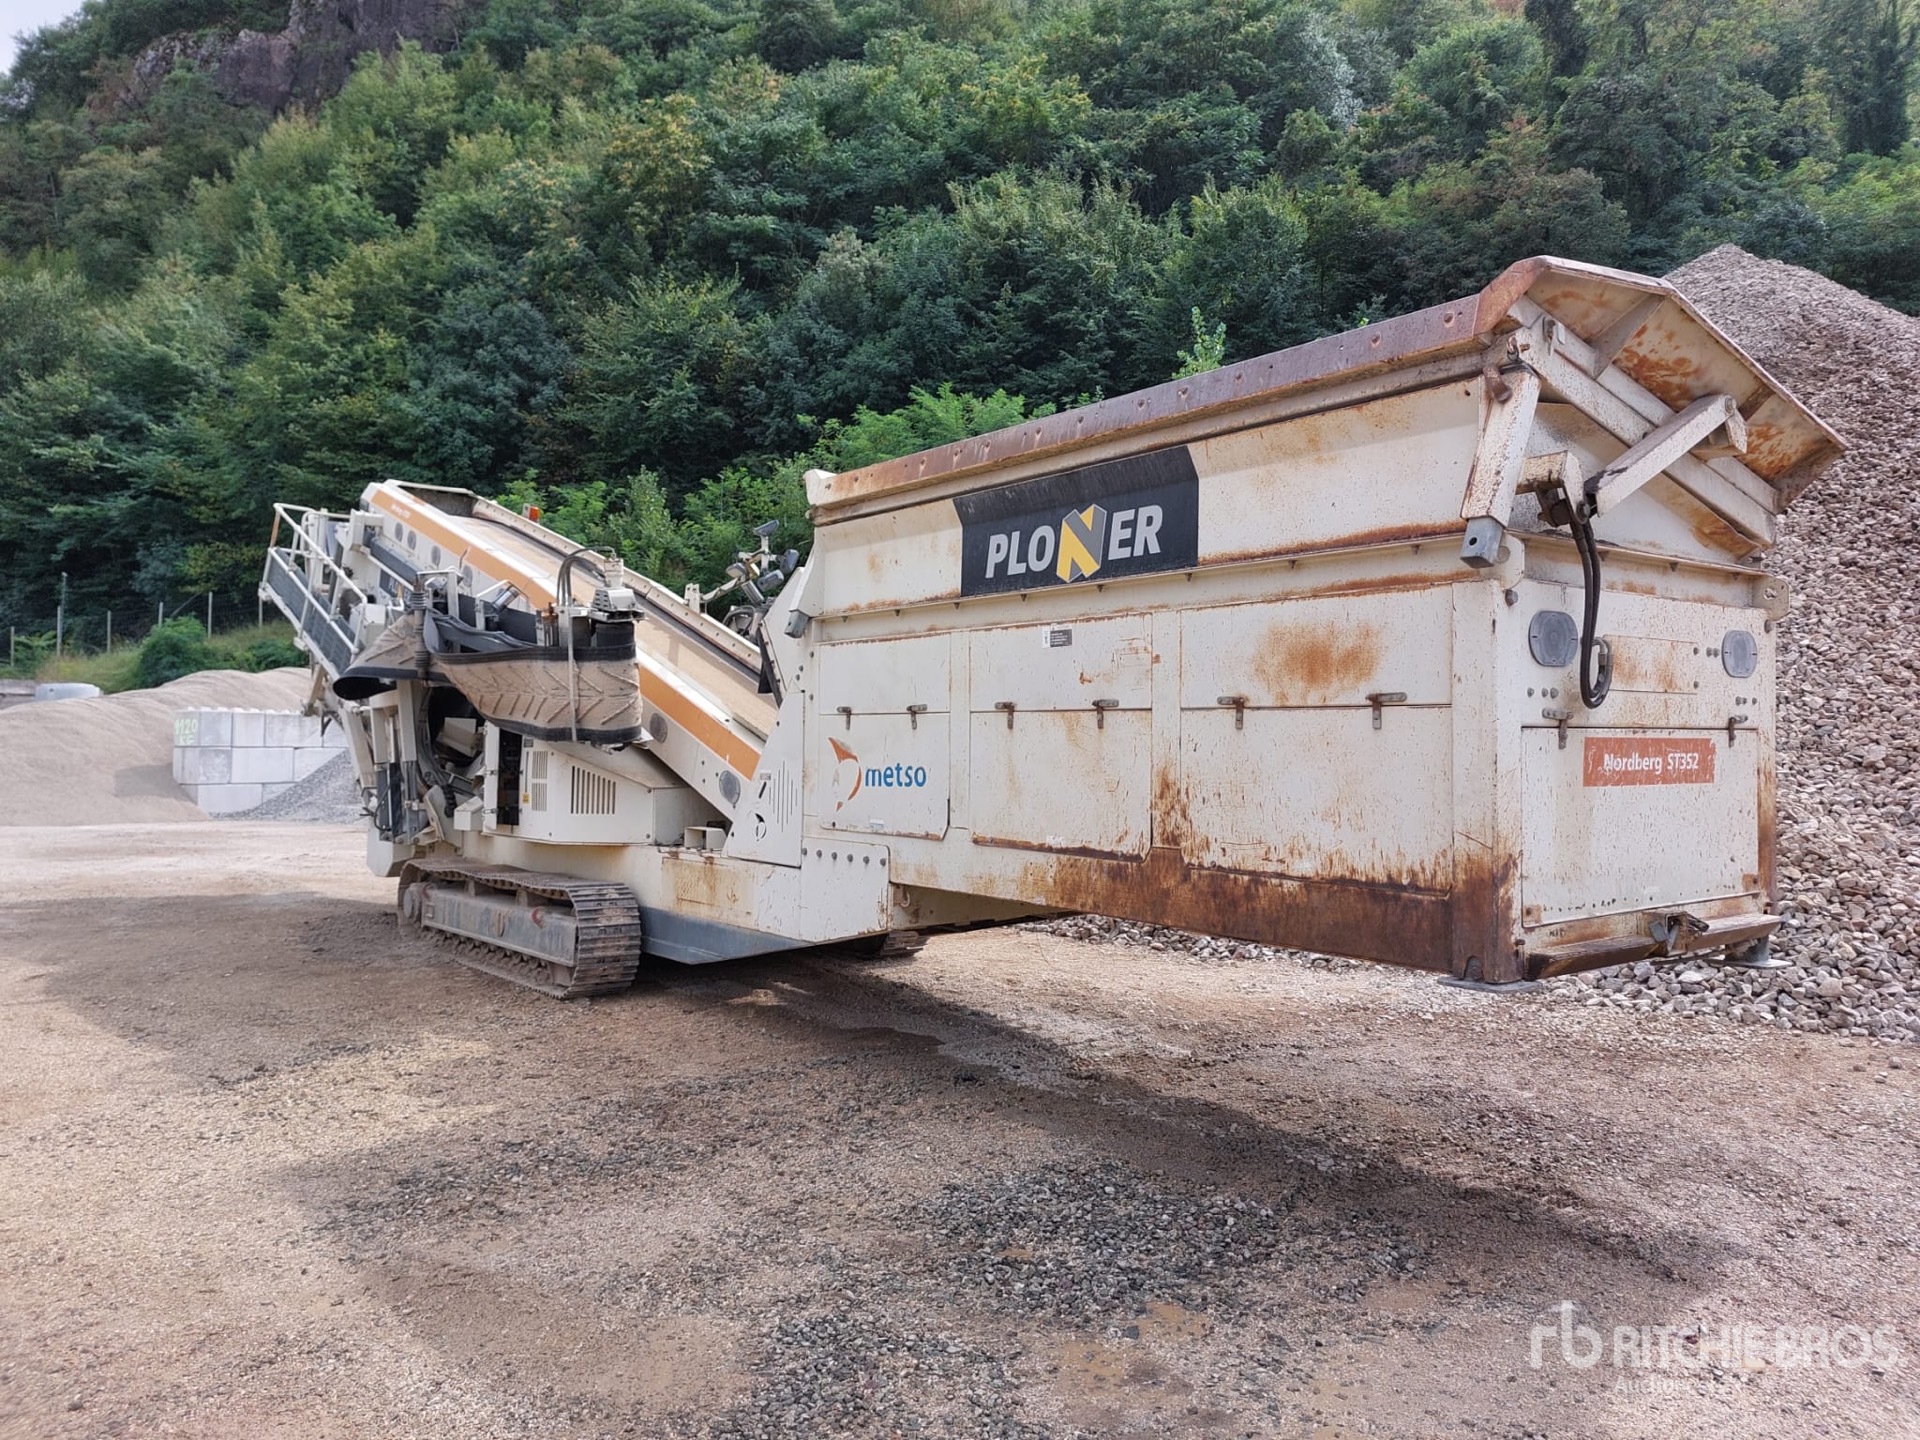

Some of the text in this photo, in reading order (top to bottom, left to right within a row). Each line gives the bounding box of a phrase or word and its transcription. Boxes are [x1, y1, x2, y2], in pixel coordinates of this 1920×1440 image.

[984, 502, 1164, 584] PLONER
[864, 762, 927, 787] metso
[1603, 752, 1699, 775] Nordberg ST352
